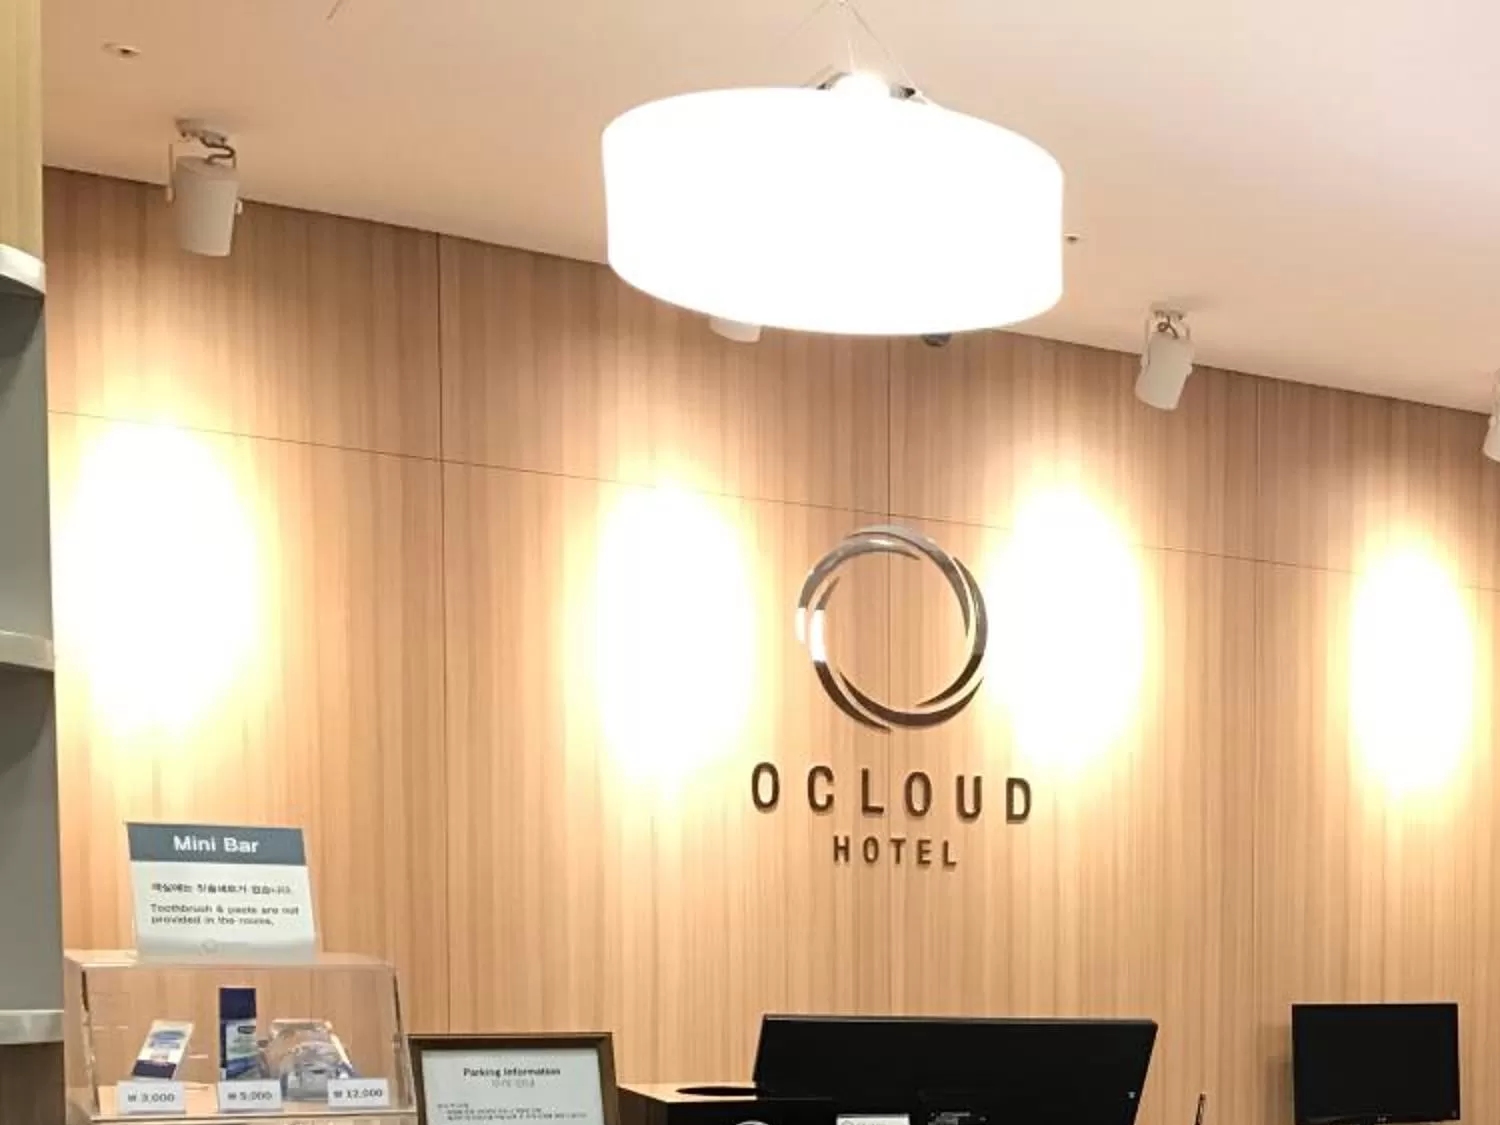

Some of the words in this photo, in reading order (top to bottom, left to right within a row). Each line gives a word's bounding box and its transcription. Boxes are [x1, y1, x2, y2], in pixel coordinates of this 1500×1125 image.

[751, 762, 1032, 824] OCLOUD
[173, 836, 216, 852] Mini
[223, 837, 260, 853] Bar
[833, 835, 958, 871] HOTEL
[150, 903, 212, 914] Toothbrush
[151, 915, 201, 926] provided
[463, 1067, 501, 1078] Parking
